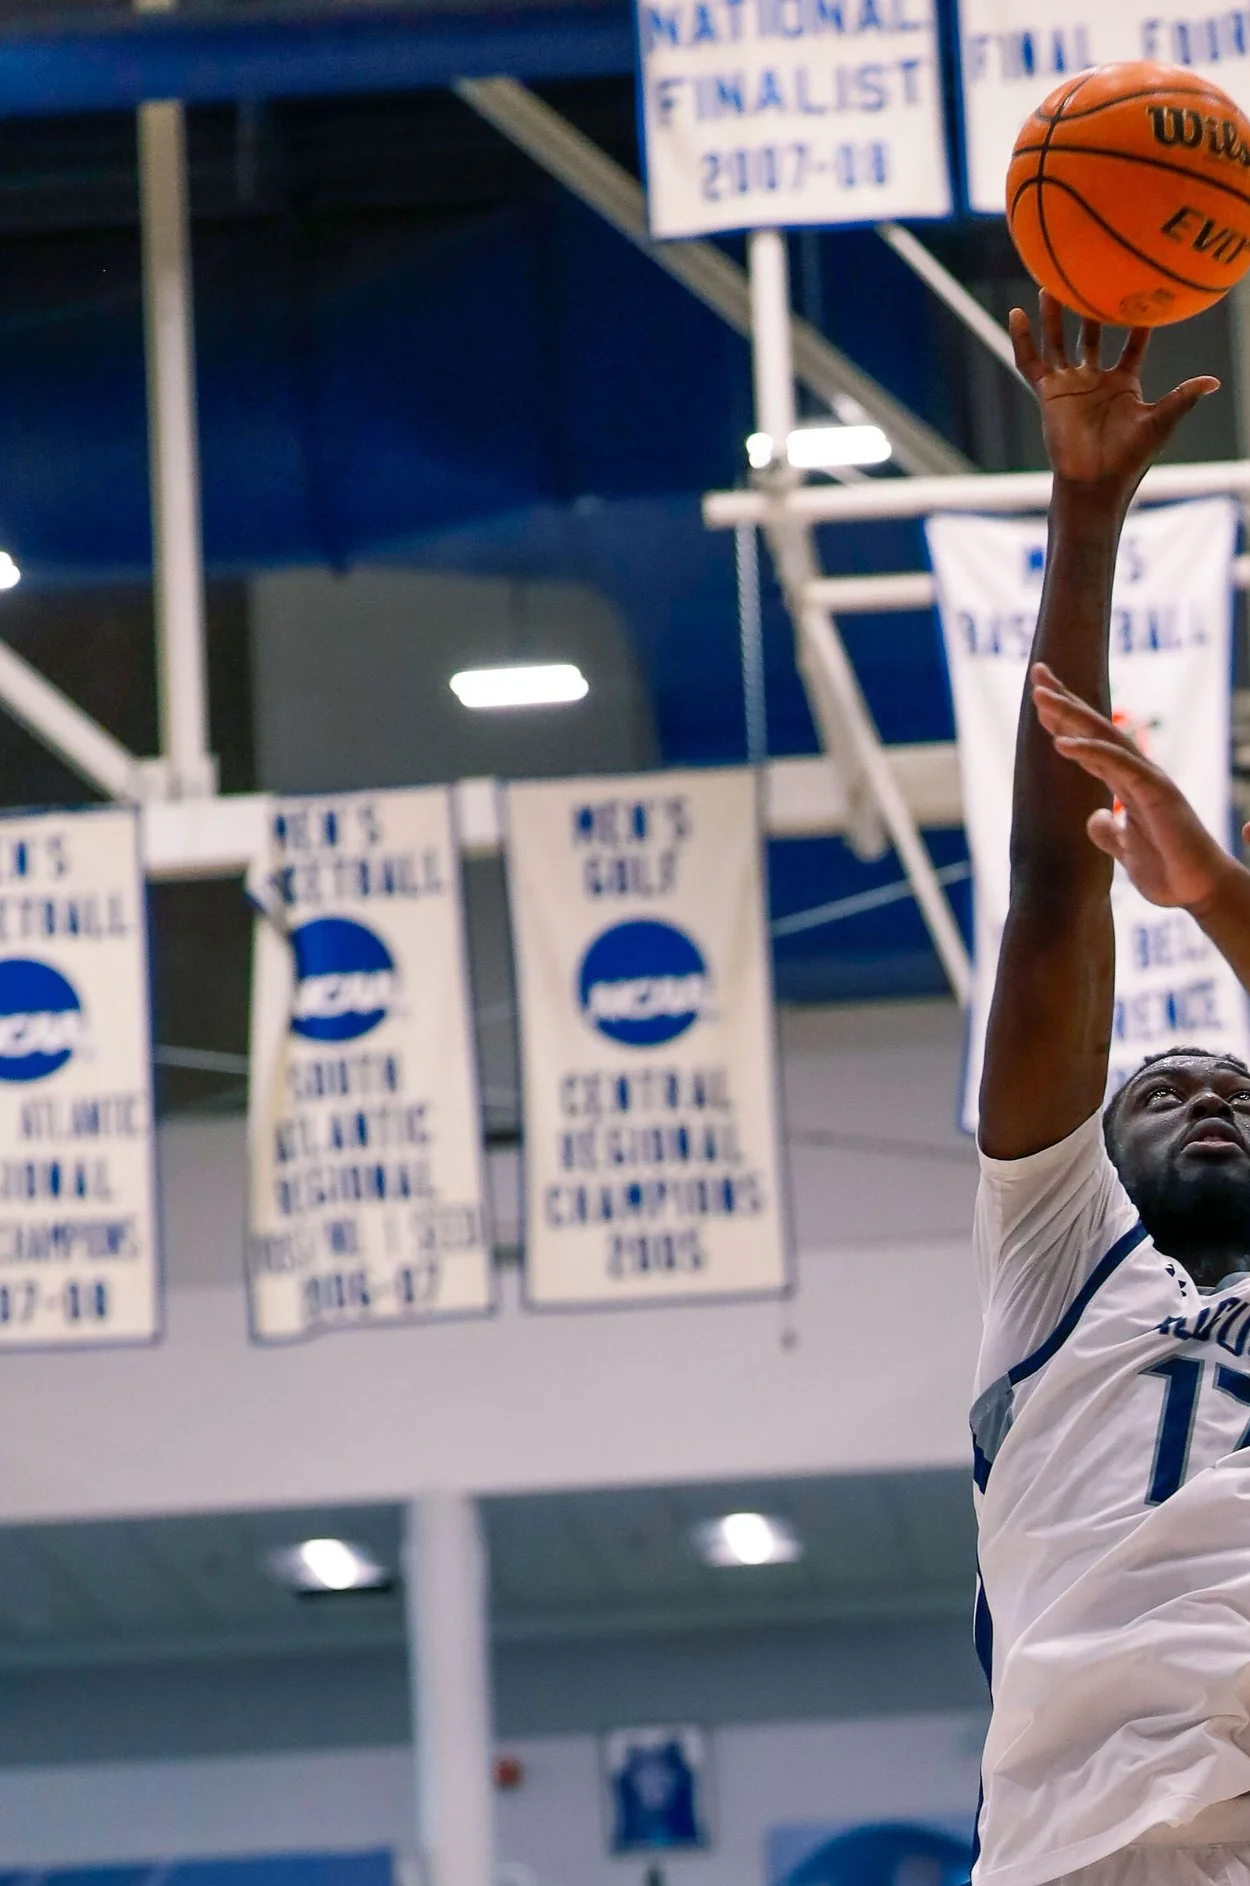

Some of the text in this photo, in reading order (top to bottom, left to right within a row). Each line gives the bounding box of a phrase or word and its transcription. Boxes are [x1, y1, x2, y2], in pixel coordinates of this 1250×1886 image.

[655, 58, 921, 124] FINALIST
[571, 793, 691, 844] MEN'S
[584, 849, 677, 900] GOLF
[559, 1068, 734, 1118] CENTRAL
[275, 1103, 428, 1164] ATLANTIC
[556, 1123, 743, 1175] REGIONAL
[276, 1161, 435, 1217] REGIONAL
[543, 1175, 765, 1231] CHAMPIONS
